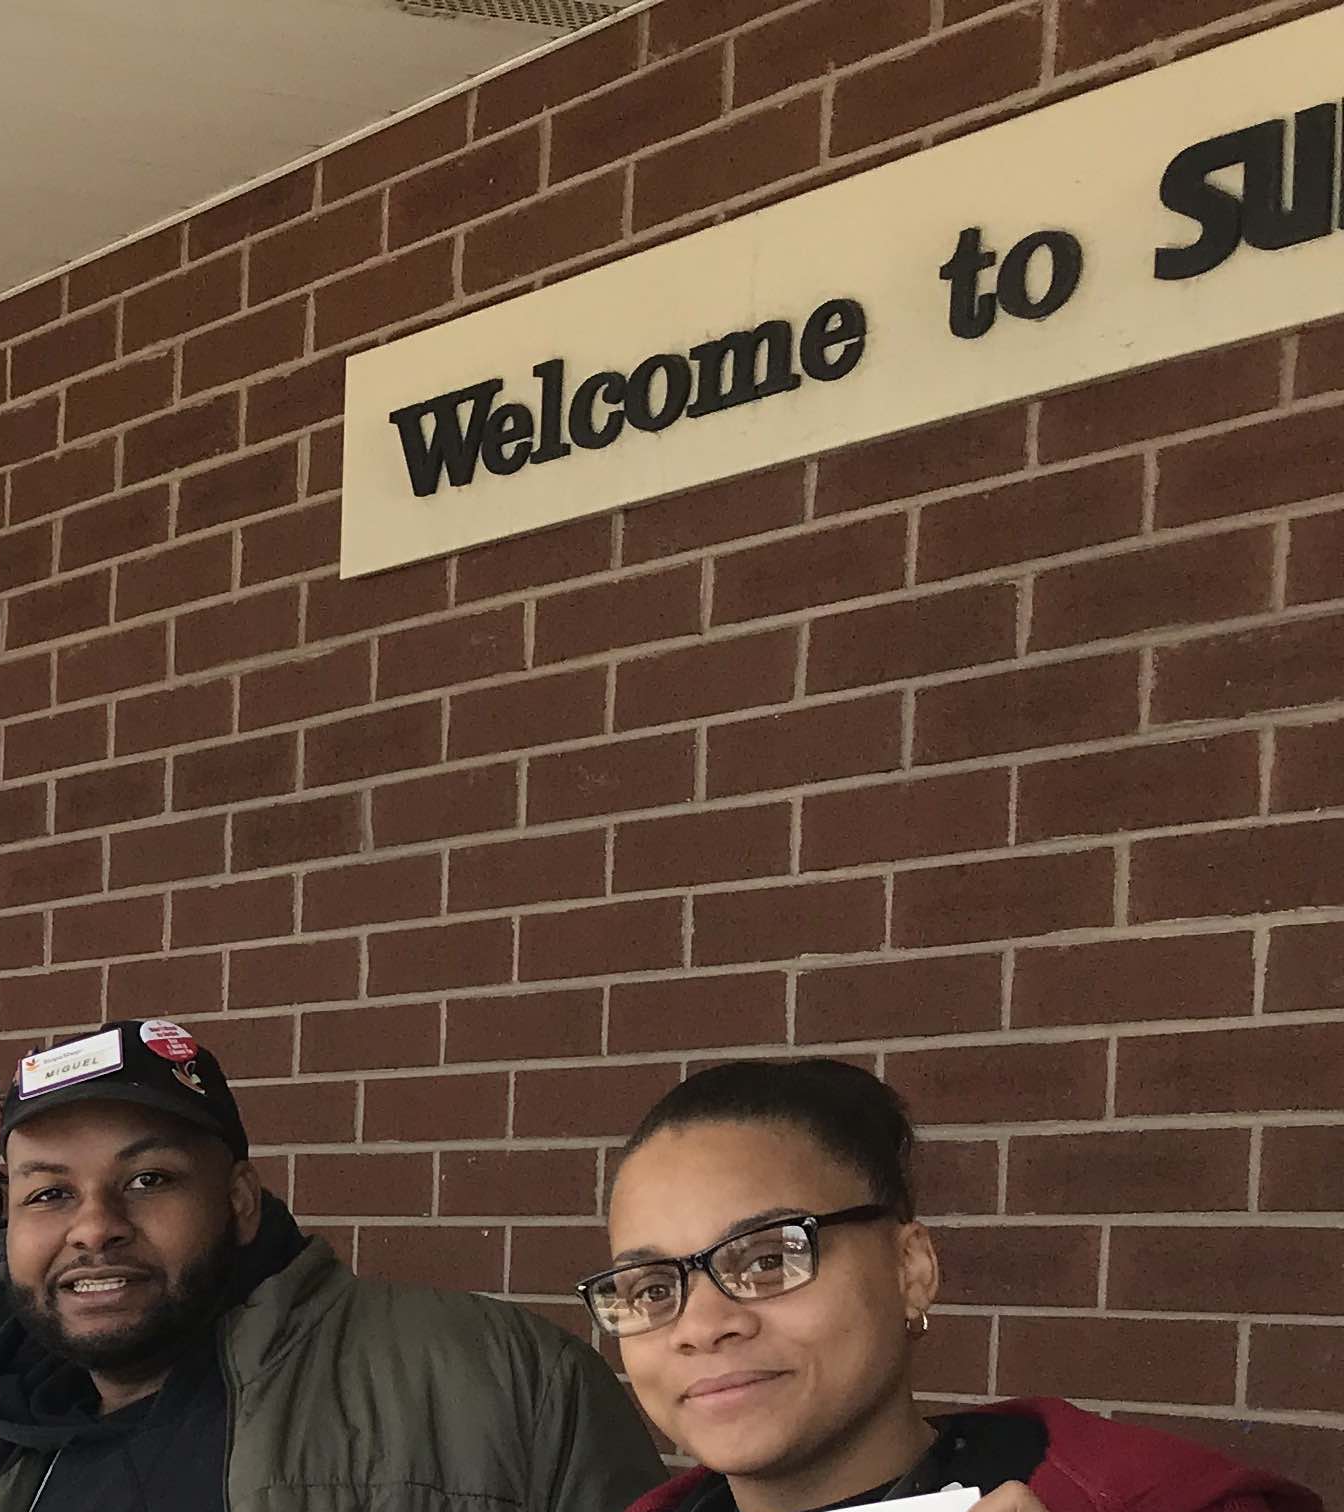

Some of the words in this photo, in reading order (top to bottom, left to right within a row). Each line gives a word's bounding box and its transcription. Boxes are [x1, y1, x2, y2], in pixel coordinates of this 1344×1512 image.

[389, 296, 868, 497] Welcome
[940, 226, 1083, 340] to
[1154, 97, 1344, 280] SU
[45, 1057, 99, 1080] MIGUEL
